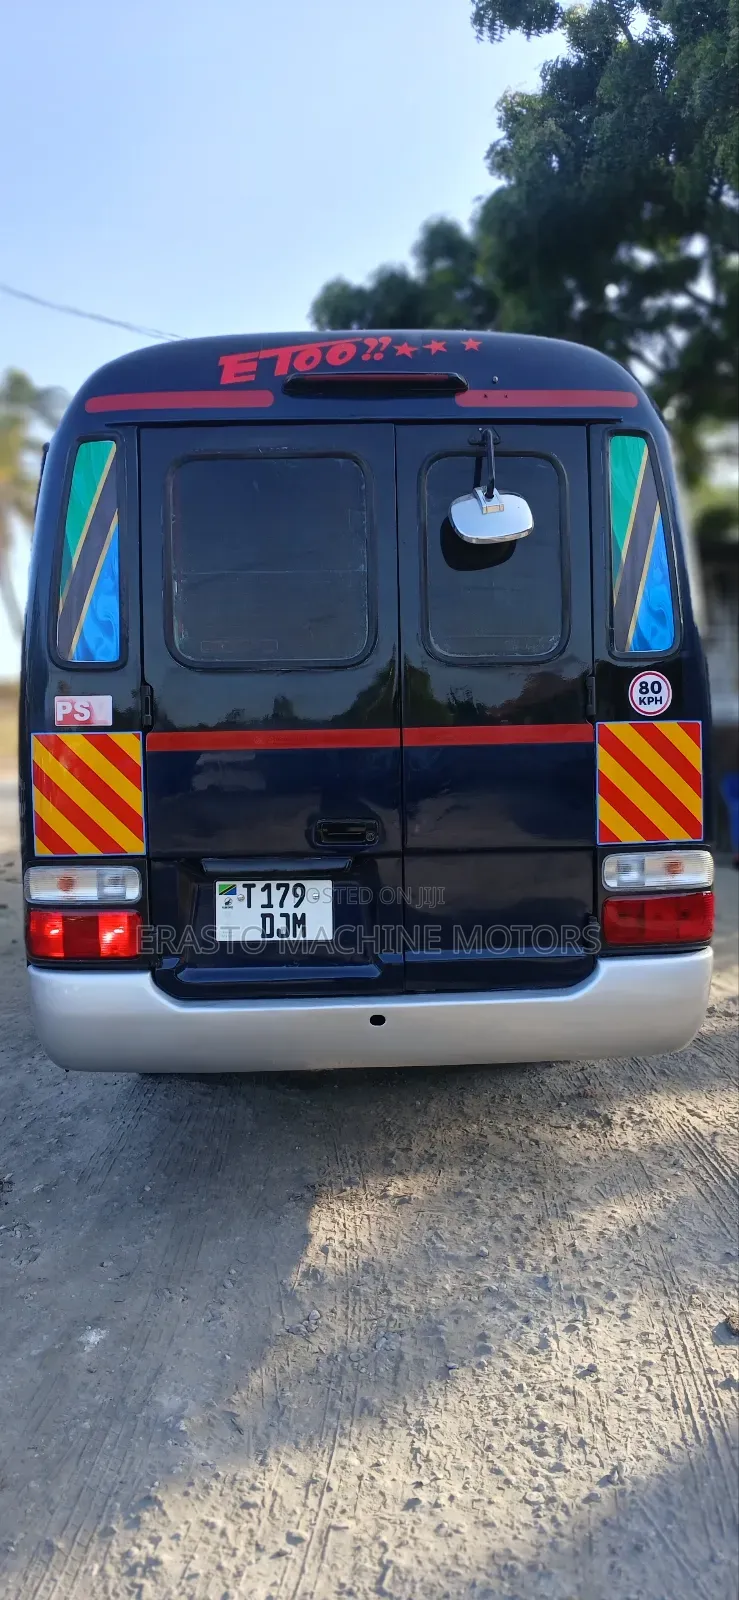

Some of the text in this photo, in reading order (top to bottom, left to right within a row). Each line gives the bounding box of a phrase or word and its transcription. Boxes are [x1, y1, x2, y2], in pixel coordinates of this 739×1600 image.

[638, 680, 662, 695] 80
[638, 696, 663, 706] KPH
[260, 912, 306, 939] DJM
